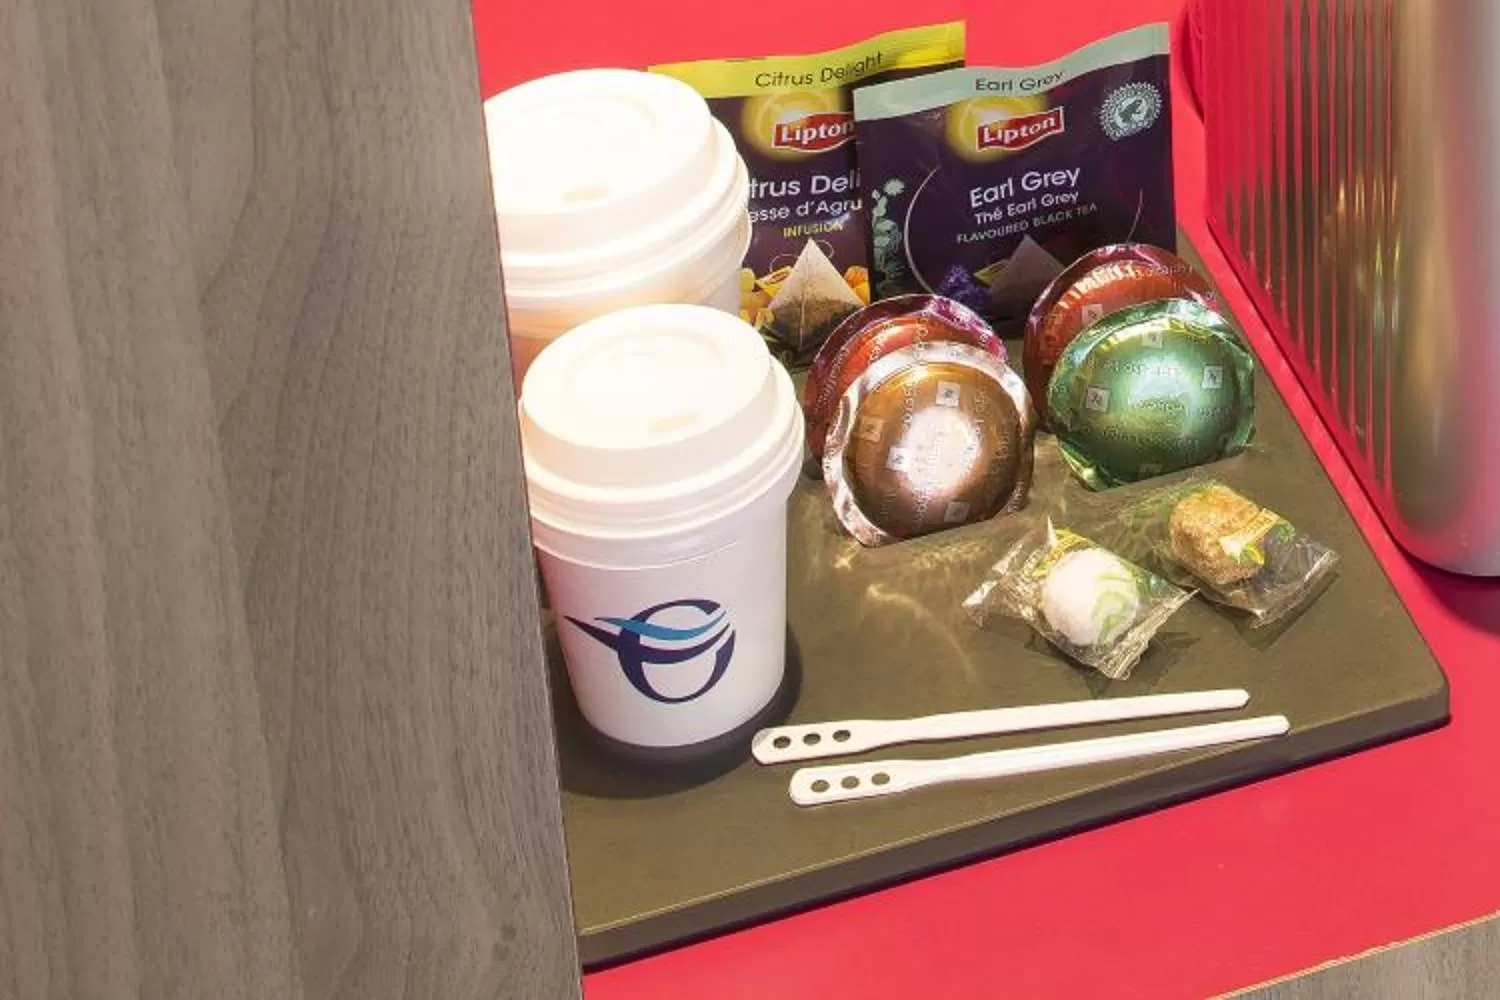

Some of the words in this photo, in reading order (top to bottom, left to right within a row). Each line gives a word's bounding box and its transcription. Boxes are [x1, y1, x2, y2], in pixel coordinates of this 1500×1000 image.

[755, 71, 813, 88] Citrus
[820, 51, 883, 83] Delight
[975, 77, 1013, 92] Earl
[1019, 70, 1064, 90] Grey
[982, 115, 1057, 144] Lipton
[749, 178, 801, 199] trus
[810, 168, 861, 195] Deli
[969, 177, 1014, 209] Earl
[1021, 167, 1081, 191] Grey
[748, 206, 791, 223] esse
[796, 198, 863, 218] d'Agru
[956, 220, 1029, 244] FLAVOURED
[1032, 209, 1073, 228] BLACK
[1076, 202, 1098, 217] TEA
[974, 207, 1003, 225] Thé
[1007, 198, 1037, 217] Earl
[1041, 191, 1079, 208] Grey
[783, 220, 844, 239] INFUSION
